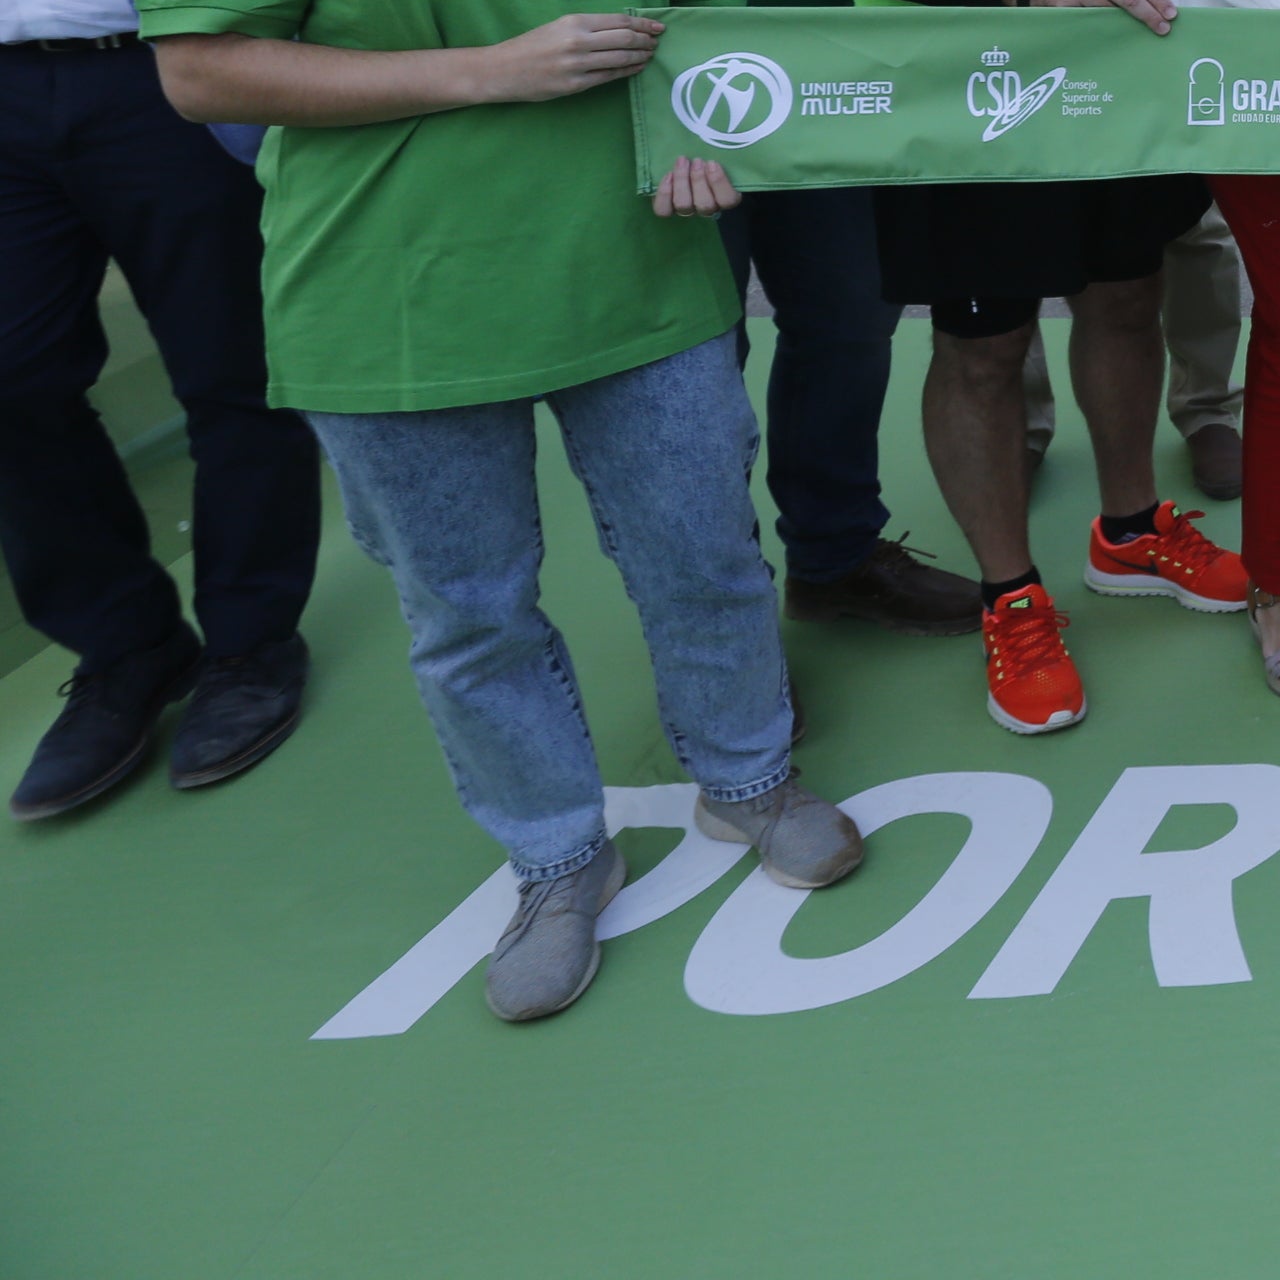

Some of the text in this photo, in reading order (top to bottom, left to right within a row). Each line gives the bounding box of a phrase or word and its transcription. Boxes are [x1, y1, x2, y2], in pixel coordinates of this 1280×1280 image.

[801, 81, 893, 96] UNIVERSO
[1062, 79, 1098, 91] Consejo
[1062, 92, 1113, 104] Superior de
[801, 96, 892, 116] MUJER
[1062, 105, 1102, 117] Deportes
[1232, 113, 1264, 123] CIUDAD
